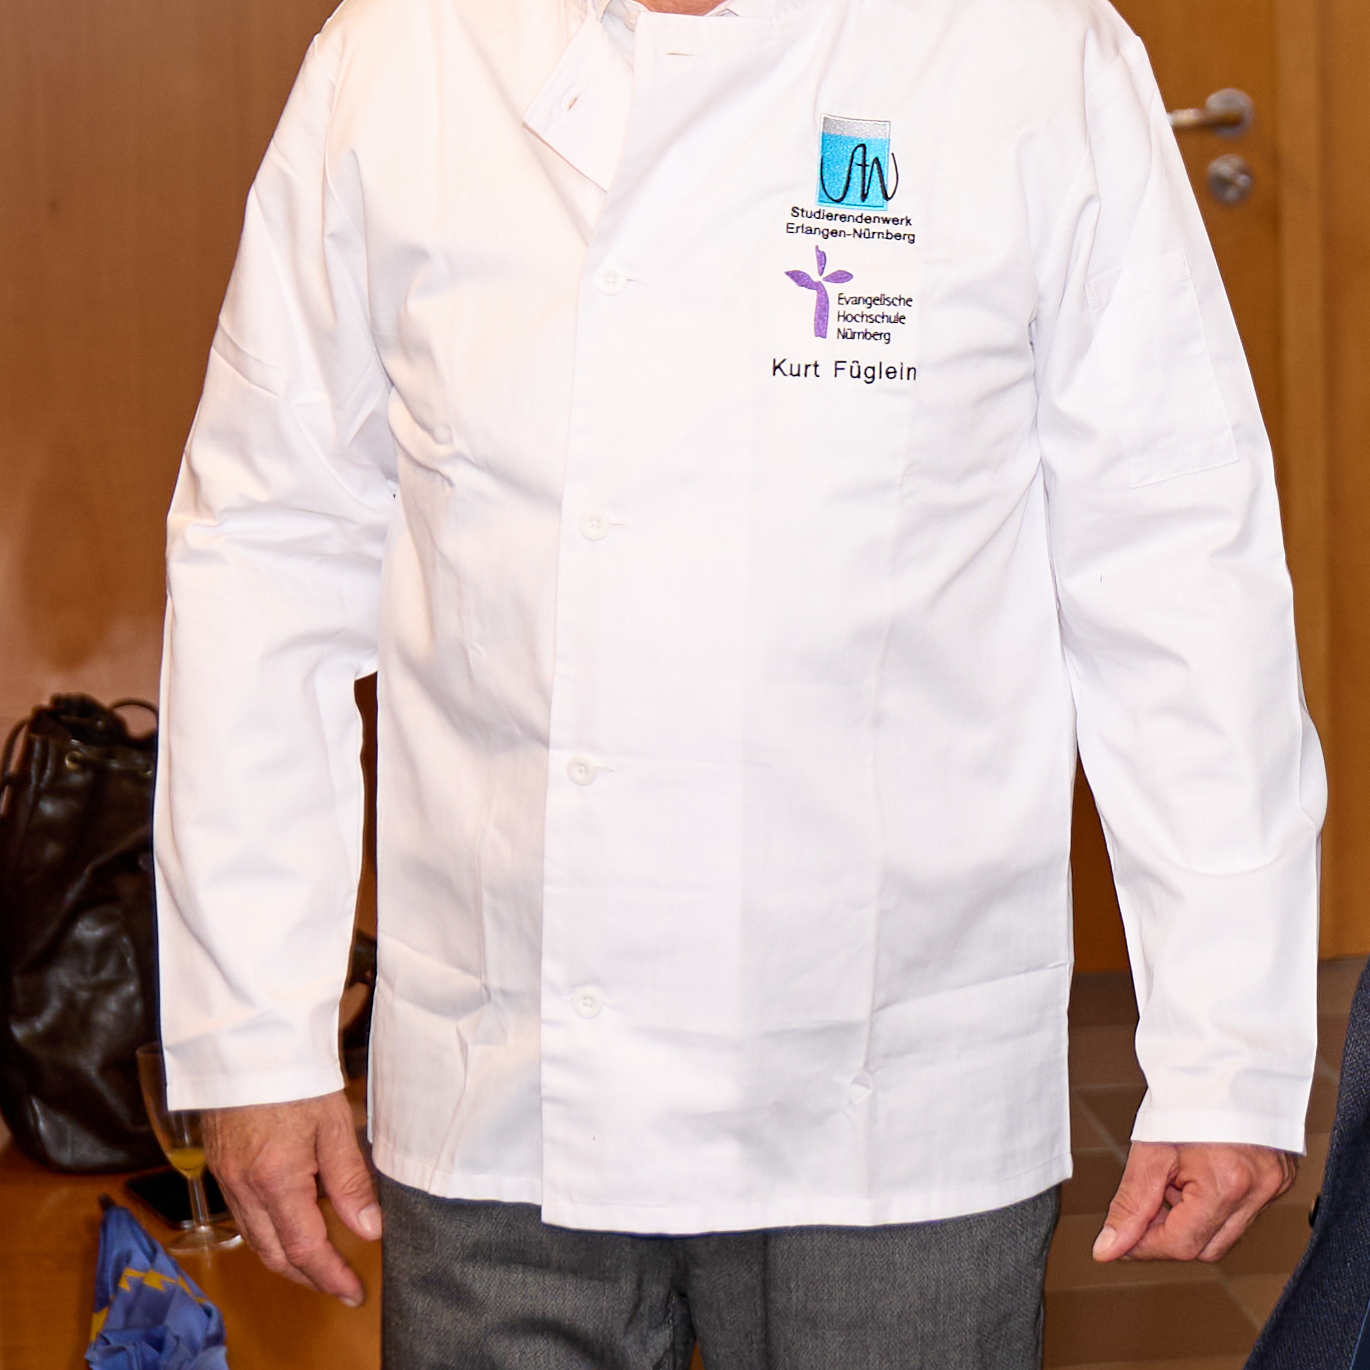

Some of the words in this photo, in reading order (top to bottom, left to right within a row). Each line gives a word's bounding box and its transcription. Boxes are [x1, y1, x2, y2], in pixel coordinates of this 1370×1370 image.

[790, 206, 912, 227] Studierendenwerk
[786, 222, 916, 244] Erlangen-Nürnberg
[837, 293, 913, 308] Evangelische
[837, 310, 907, 325] Hochschule
[837, 328, 891, 344] Nürnberg
[772, 358, 820, 378] Kurt
[833, 359, 917, 384] Füglein
